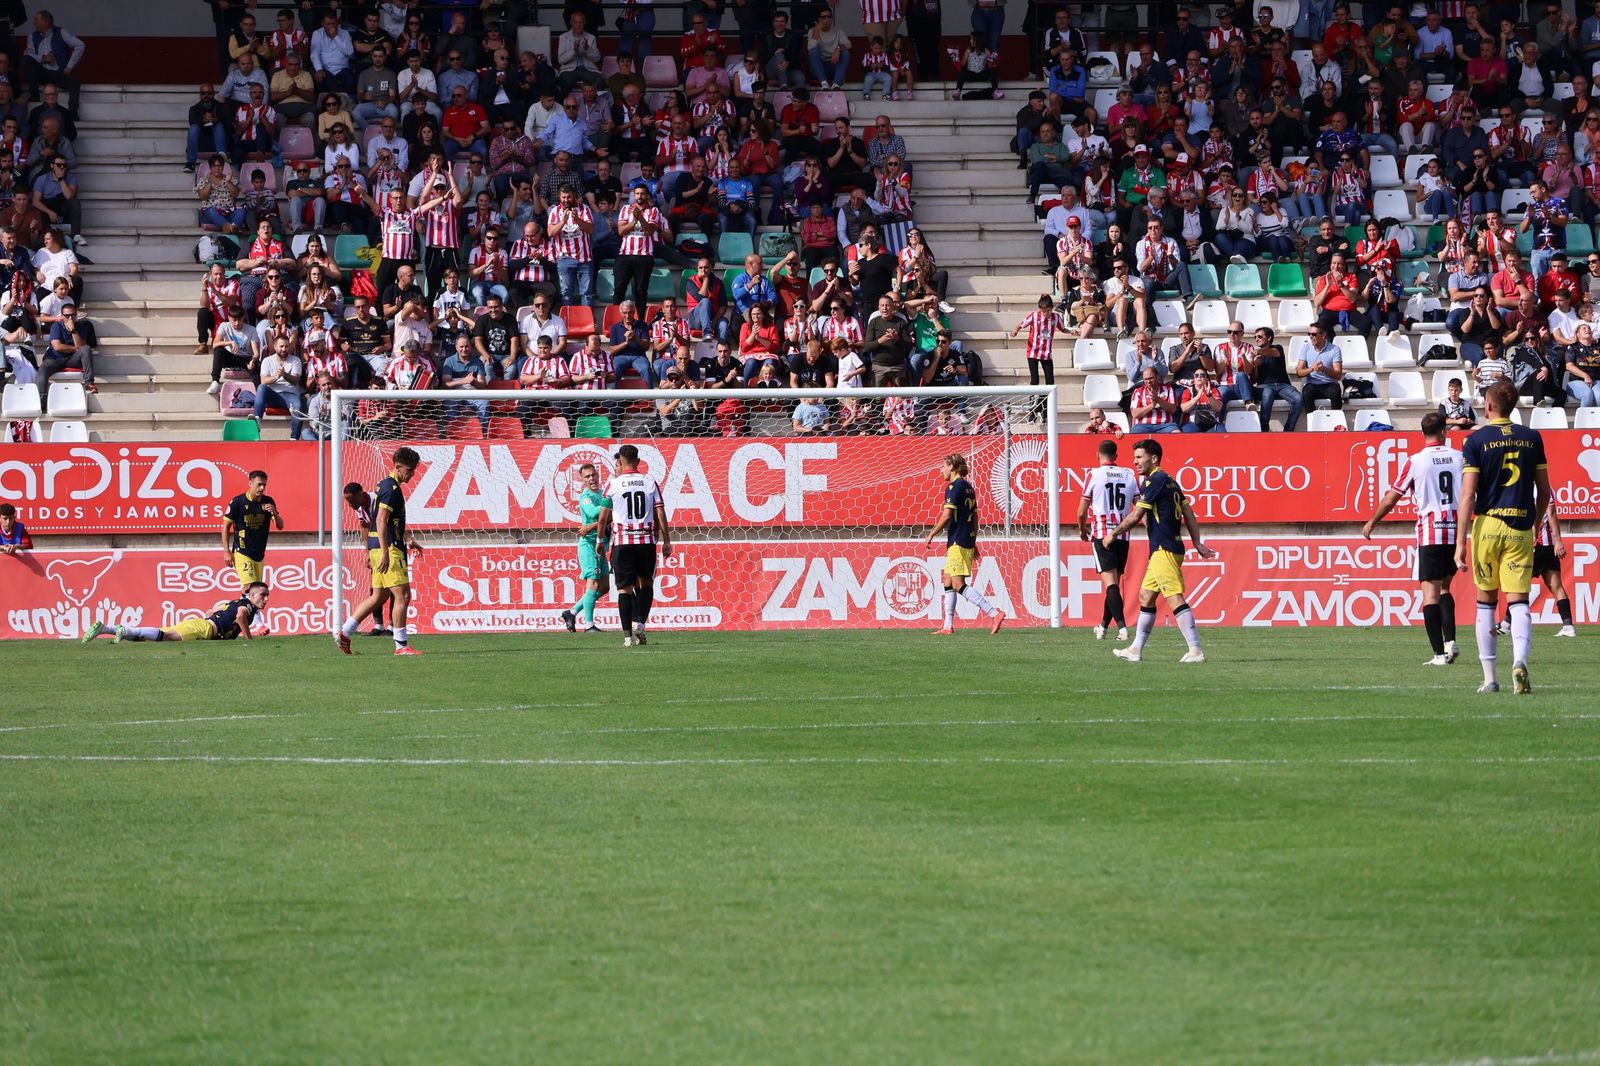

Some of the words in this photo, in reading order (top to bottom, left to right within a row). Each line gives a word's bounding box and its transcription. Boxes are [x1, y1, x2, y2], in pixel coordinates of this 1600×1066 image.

[728, 442, 838, 523] CF
[1175, 457, 1311, 492] ÓPTICO
[1500, 450, 1521, 488] 5
[621, 490, 646, 520] 10
[1105, 482, 1126, 511] 16
[1438, 470, 1453, 505] 9
[95, 506, 105, 518] Y
[113, 504, 224, 519] JAMONES
[482, 556, 579, 574] bodegas
[438, 565, 711, 606] Sumer
[762, 555, 1017, 622] ZAMORA
[1022, 554, 1102, 620] CF
[1242, 589, 1425, 627] ZAMORA
